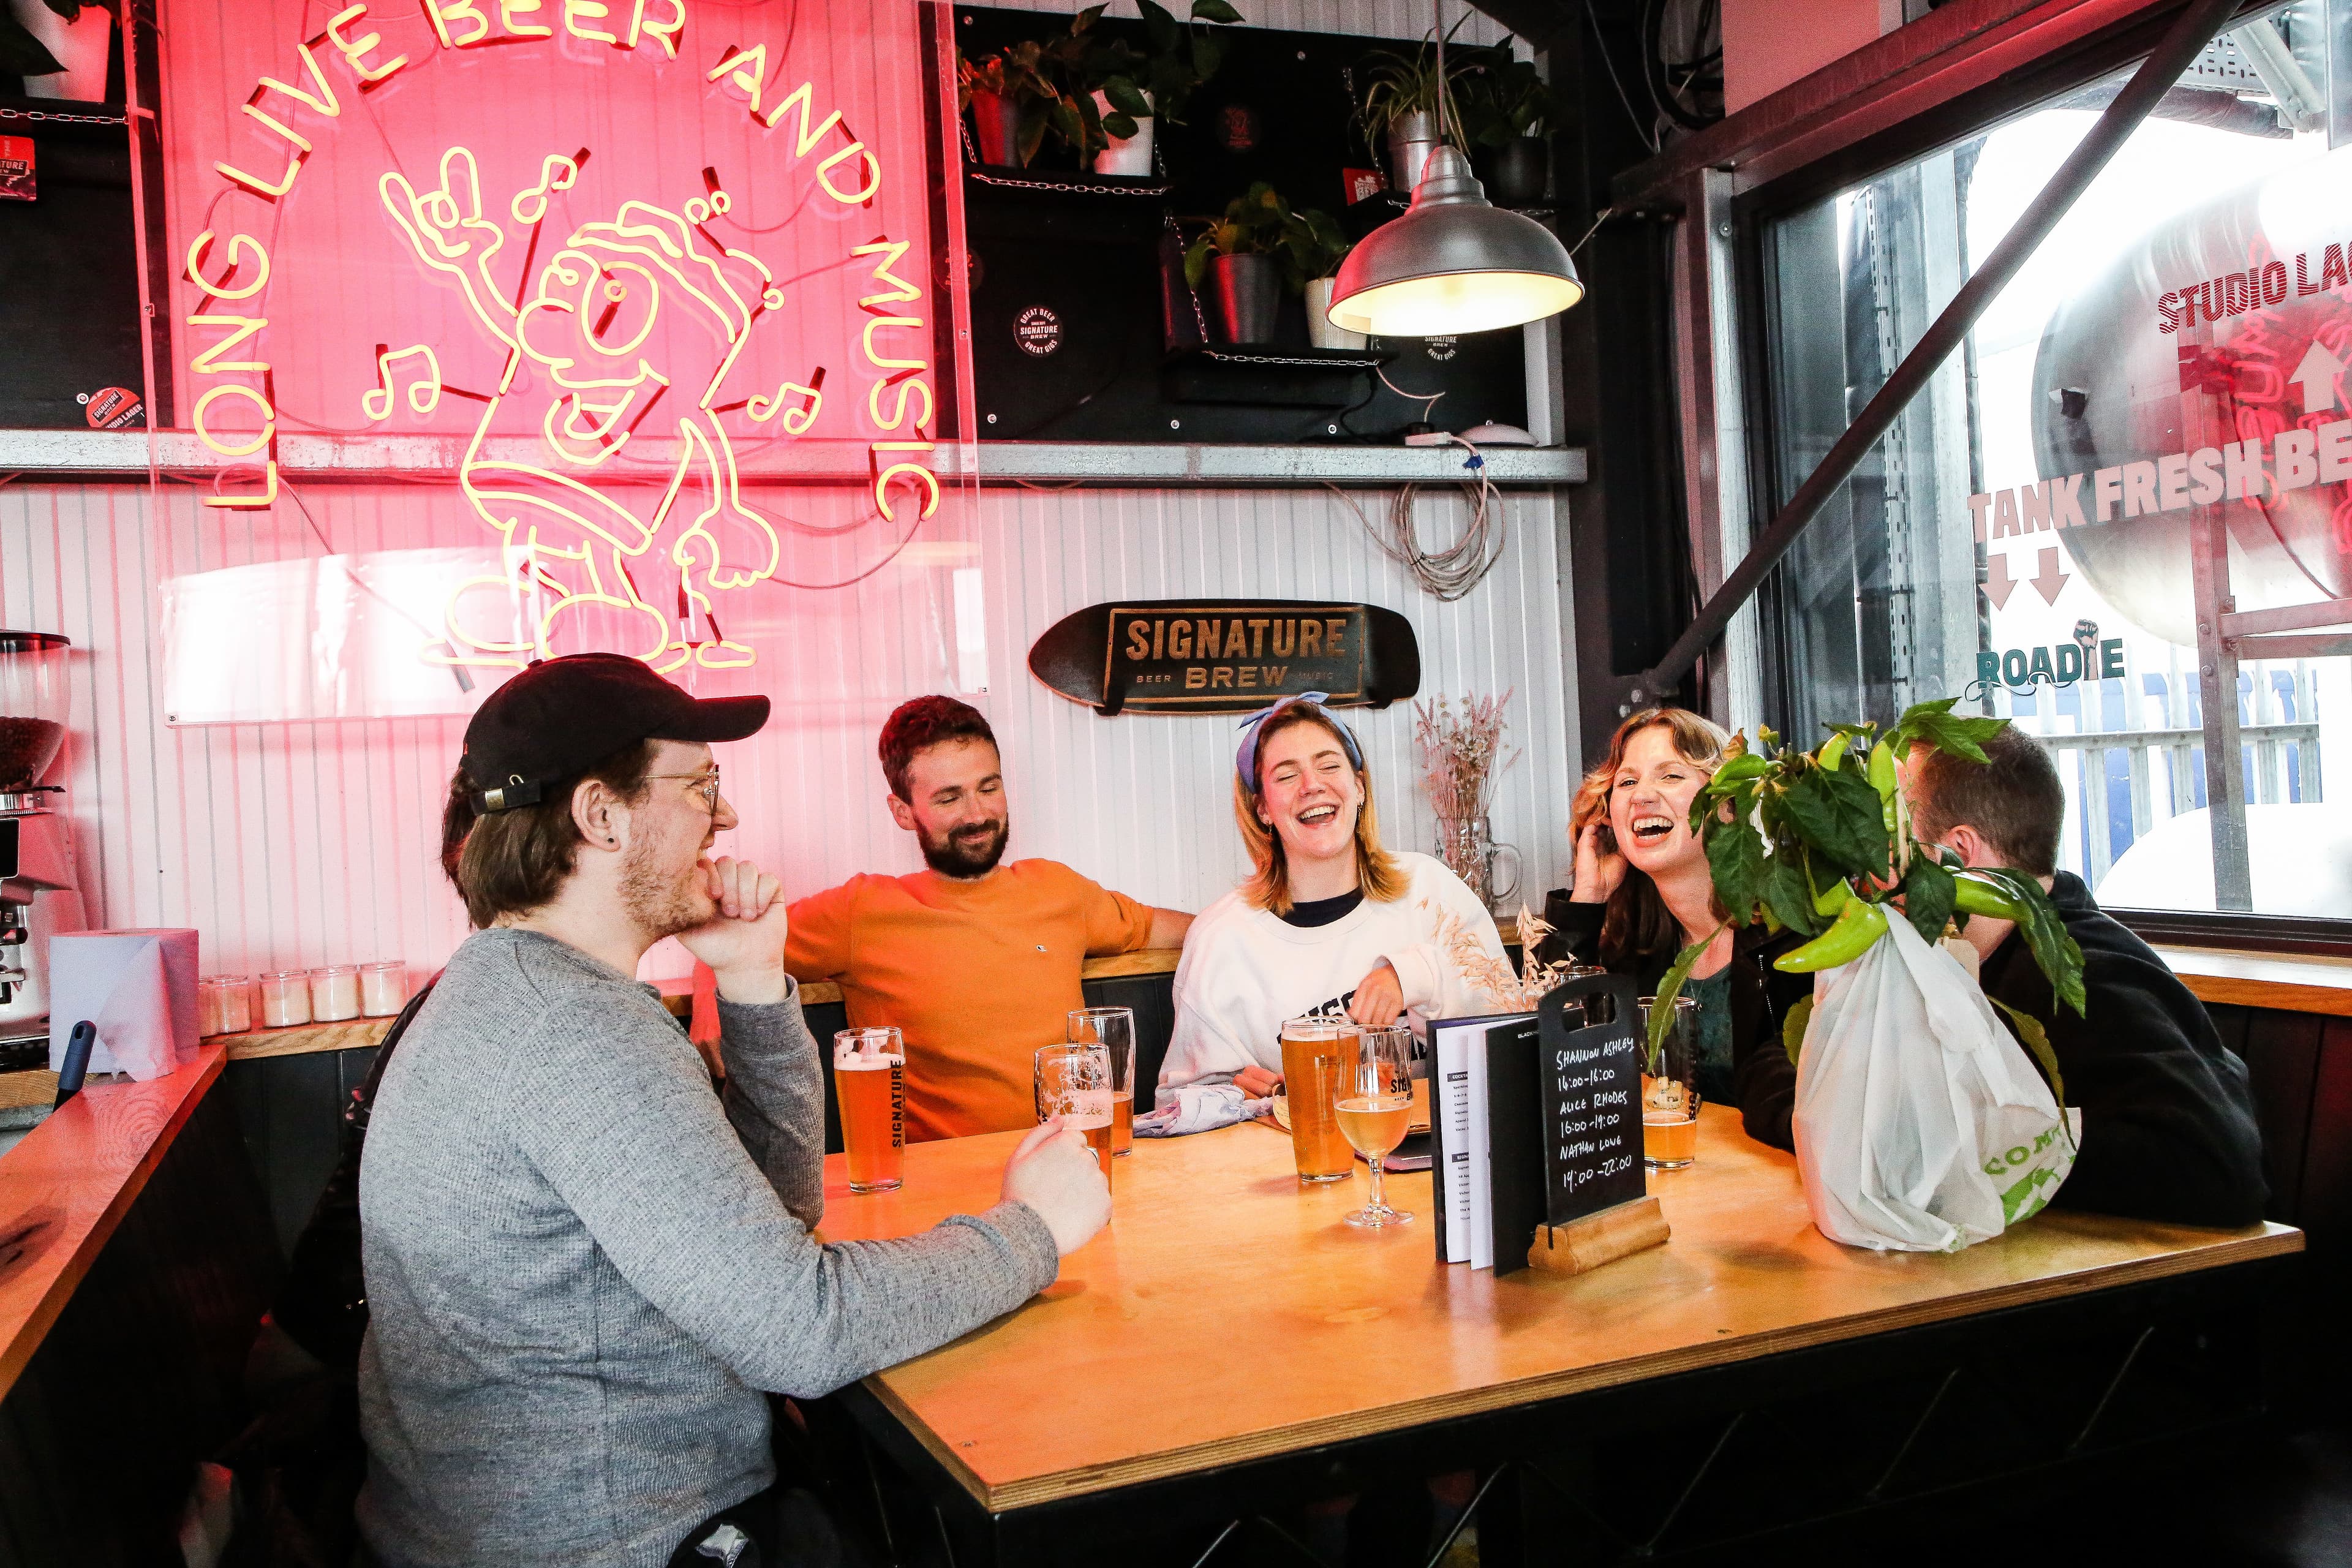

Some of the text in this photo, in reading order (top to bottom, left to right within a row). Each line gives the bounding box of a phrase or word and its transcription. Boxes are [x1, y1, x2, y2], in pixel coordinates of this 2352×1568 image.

[0, 160, 24, 170] TURE
[187, 0, 940, 522] LONG LIVE BEER AND MUSIC
[2158, 241, 2352, 334] STUDIO LA
[1020, 308, 1037, 324] GREAT
[1020, 325, 1058, 335] SIGNATURE
[1025, 341, 1044, 354] GREAT
[94, 392, 119, 418] SIGNATURE
[1967, 473, 2087, 544] TANK
[2094, 439, 2263, 523] FRESH
[1125, 617, 1348, 662] SIGNATURE
[1976, 620, 2125, 690] ROADIE
[1185, 666, 1288, 689] BREW
[1556, 1037, 1635, 1071] SHANNON ASHLEY
[890, 1060, 902, 1148] SIGNATURE
[1559, 1090, 1627, 1115] ALICE RHODES
[1559, 1140, 1594, 1160] NATHAN
